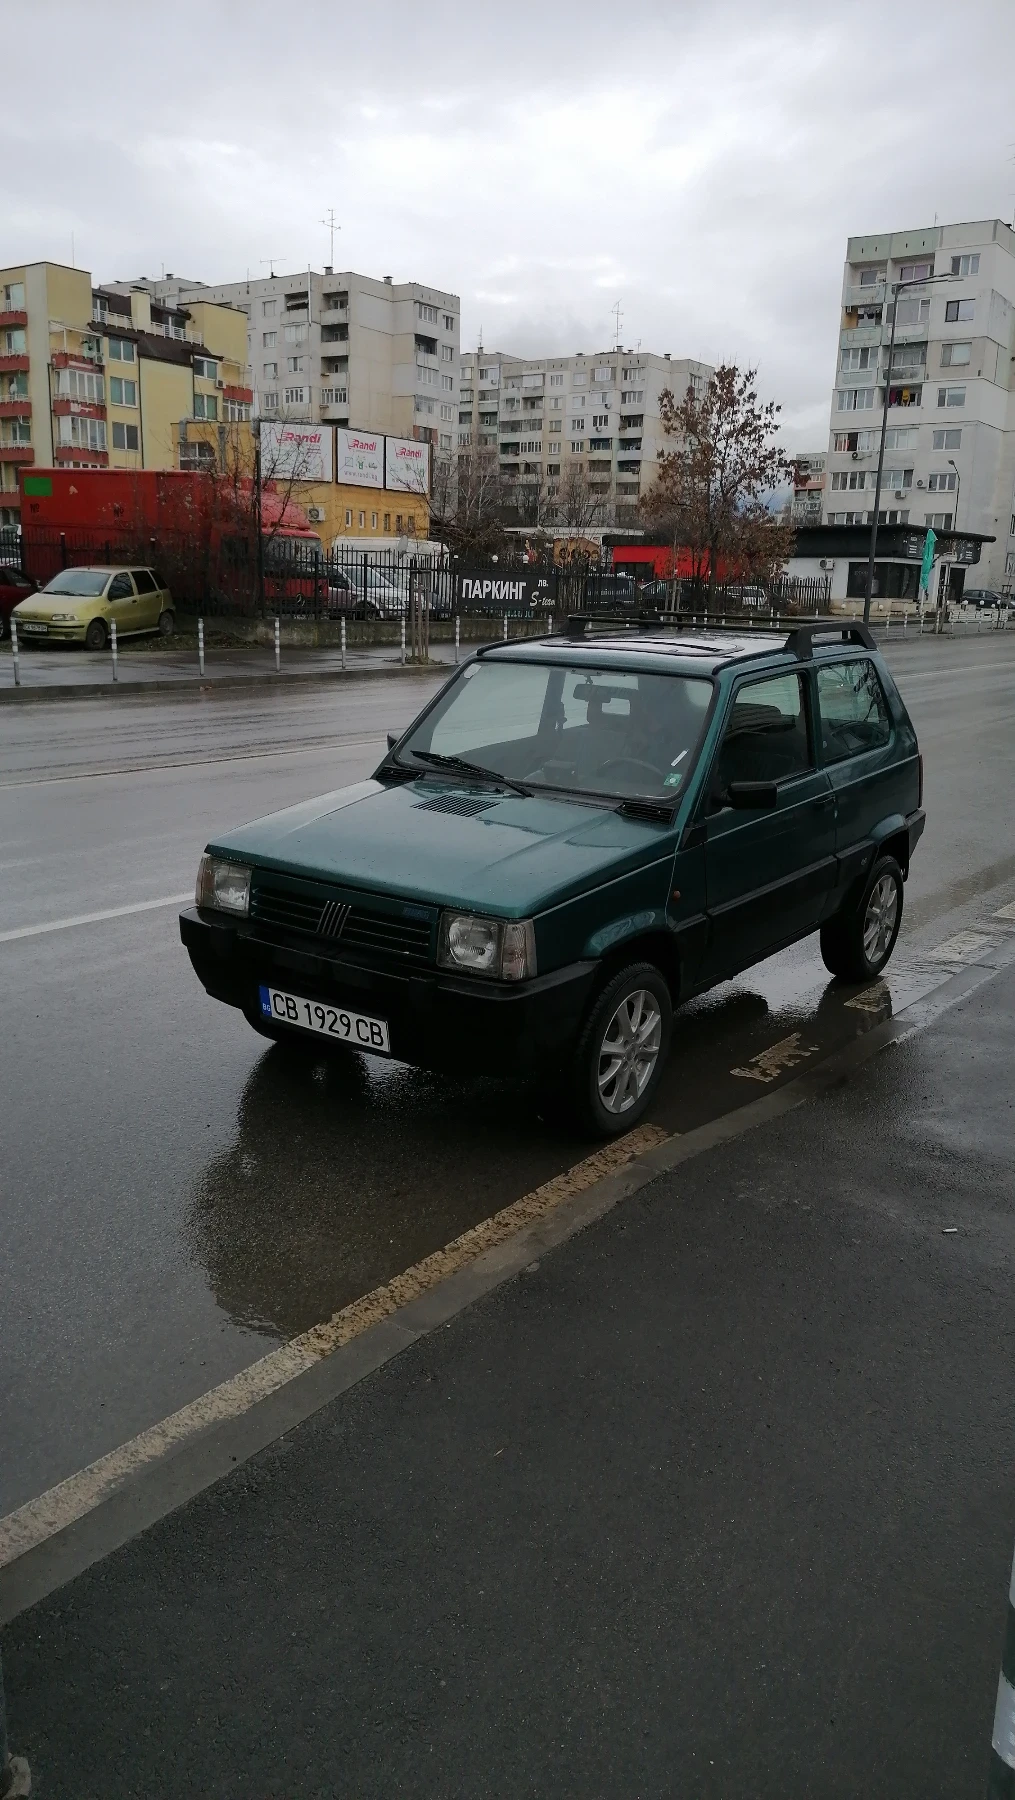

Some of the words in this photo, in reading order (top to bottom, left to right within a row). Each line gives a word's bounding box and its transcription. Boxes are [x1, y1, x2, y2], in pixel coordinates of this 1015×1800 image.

[284, 431, 322, 444] Randi
[352, 439, 377, 451] Randi
[399, 446, 422, 459] Randi
[462, 578, 527, 600] ПАРКИНГ
[262, 1002, 271, 1012] BG
[272, 993, 299, 1021] CB
[303, 1002, 351, 1037] 1929
[355, 1018, 384, 1047] CB
